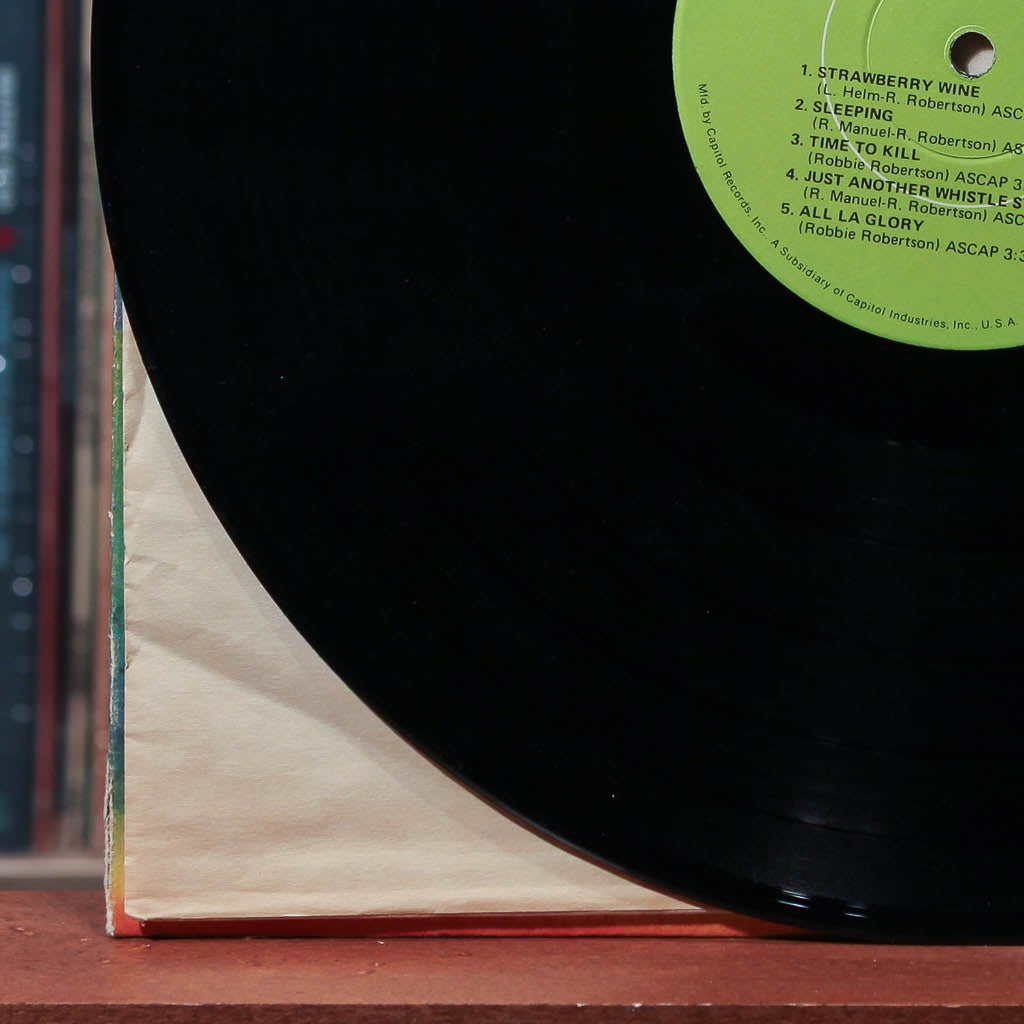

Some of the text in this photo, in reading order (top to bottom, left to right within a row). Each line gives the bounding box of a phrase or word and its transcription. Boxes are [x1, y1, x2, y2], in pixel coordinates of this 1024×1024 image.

[801, 64, 981, 98] 1. STRAWBERRY WINE
[794, 98, 894, 122] 2. SLEEPING
[817, 81, 836, 96] (L.
[843, 85, 900, 104] Helm-R.
[906, 94, 985, 116] Robertson)
[702, 111, 712, 124] by
[812, 116, 833, 131] (R.
[839, 120, 911, 141] Manuel-R.
[917, 130, 996, 152] Robertson)
[706, 128, 727, 168] Capitol
[790, 133, 921, 161] 3. TIME TO KILL
[808, 151, 865, 171] (Robbie
[870, 160, 949, 182] Robertson)
[955, 171, 1009, 188] ASCAP
[785, 168, 799, 181] 4.
[803, 170, 844, 186] JUST
[848, 176, 930, 197] ANOTHER
[935, 186, 1009, 208] WHISTLE
[803, 186, 824, 201] (R.
[830, 190, 902, 211] Manuel-R.
[908, 200, 987, 222] Robertson)
[780, 202, 925, 232] 5. ALL LA GLORY
[770, 239, 780, 248] A
[798, 220, 856, 240] (Robbie
[861, 229, 940, 252] Robertson)
[945, 240, 999, 258] ASCAP
[779, 246, 831, 290] Subsidiary
[833, 287, 845, 297] of
[846, 293, 886, 316] Capitol
